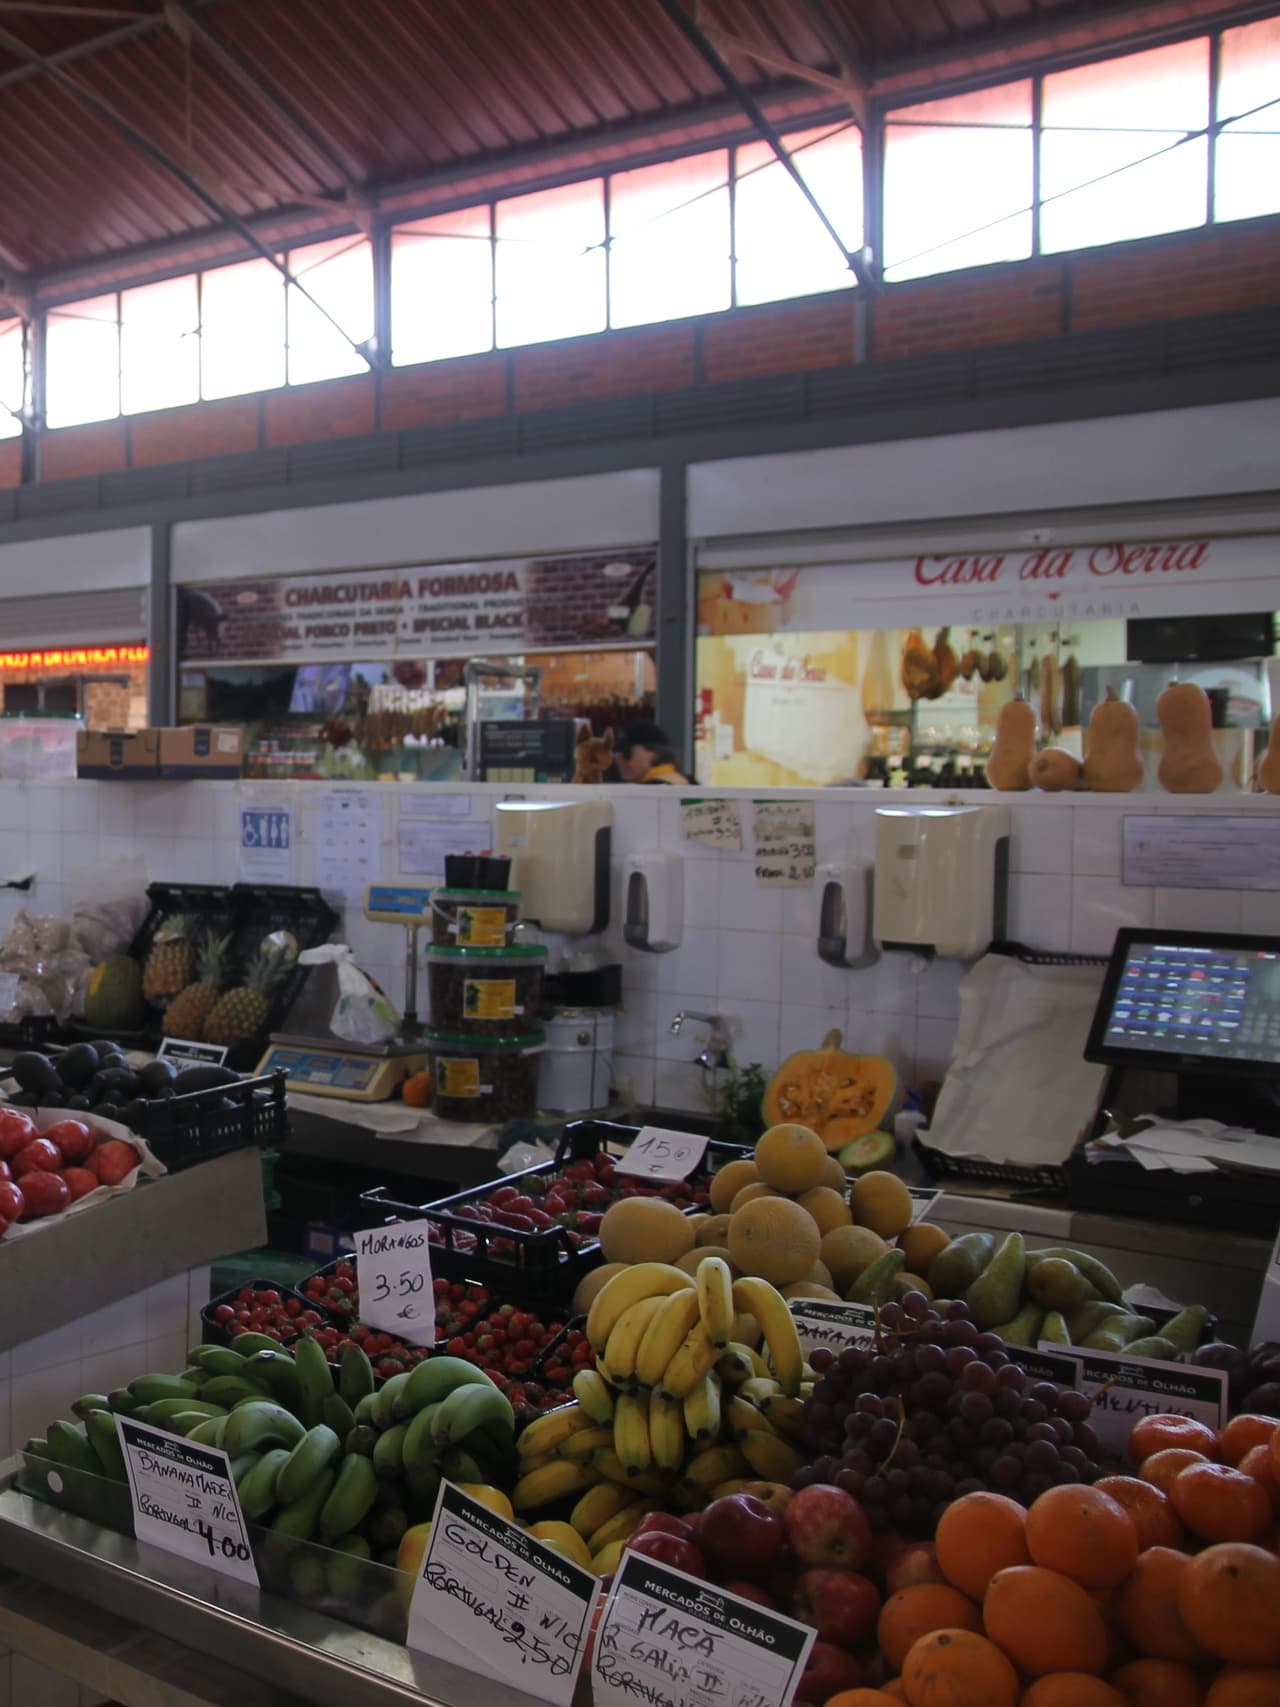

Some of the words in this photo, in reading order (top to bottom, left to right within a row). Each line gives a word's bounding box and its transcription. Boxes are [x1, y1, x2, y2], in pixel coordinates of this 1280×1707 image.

[914, 553, 1006, 586] Casa
[1019, 546, 1073, 581] da
[1086, 541, 1211, 576] Serra
[284, 578, 414, 607] CHARCUTARIA
[418, 571, 519, 598] FORMOSA
[973, 601, 1142, 621] CHARCUTARIA
[305, 622, 350, 639] PORCO
[353, 620, 398, 635] PRETO
[361, 1233, 425, 1256] MORANGOS
[371, 1270, 424, 1302] 3.50
[803, 1308, 854, 1324] MERCADOS
[1086, 1369, 1134, 1386] RCADOS
[1152, 1379, 1197, 1395] OLHÃO
[136, 1437, 176, 1457] MERCADOS
[185, 1455, 214, 1471] OLHÃO
[445, 1523, 536, 1588] GOLDEN
[461, 1508, 518, 1549] MERCADOS
[532, 1554, 572, 1584] OLHÃO
[644, 1579, 711, 1616] MERCADOS
[713, 1610, 726, 1622] DE
[729, 1617, 776, 1645] OLHÃO
[637, 1607, 724, 1658] MAÇÃ
